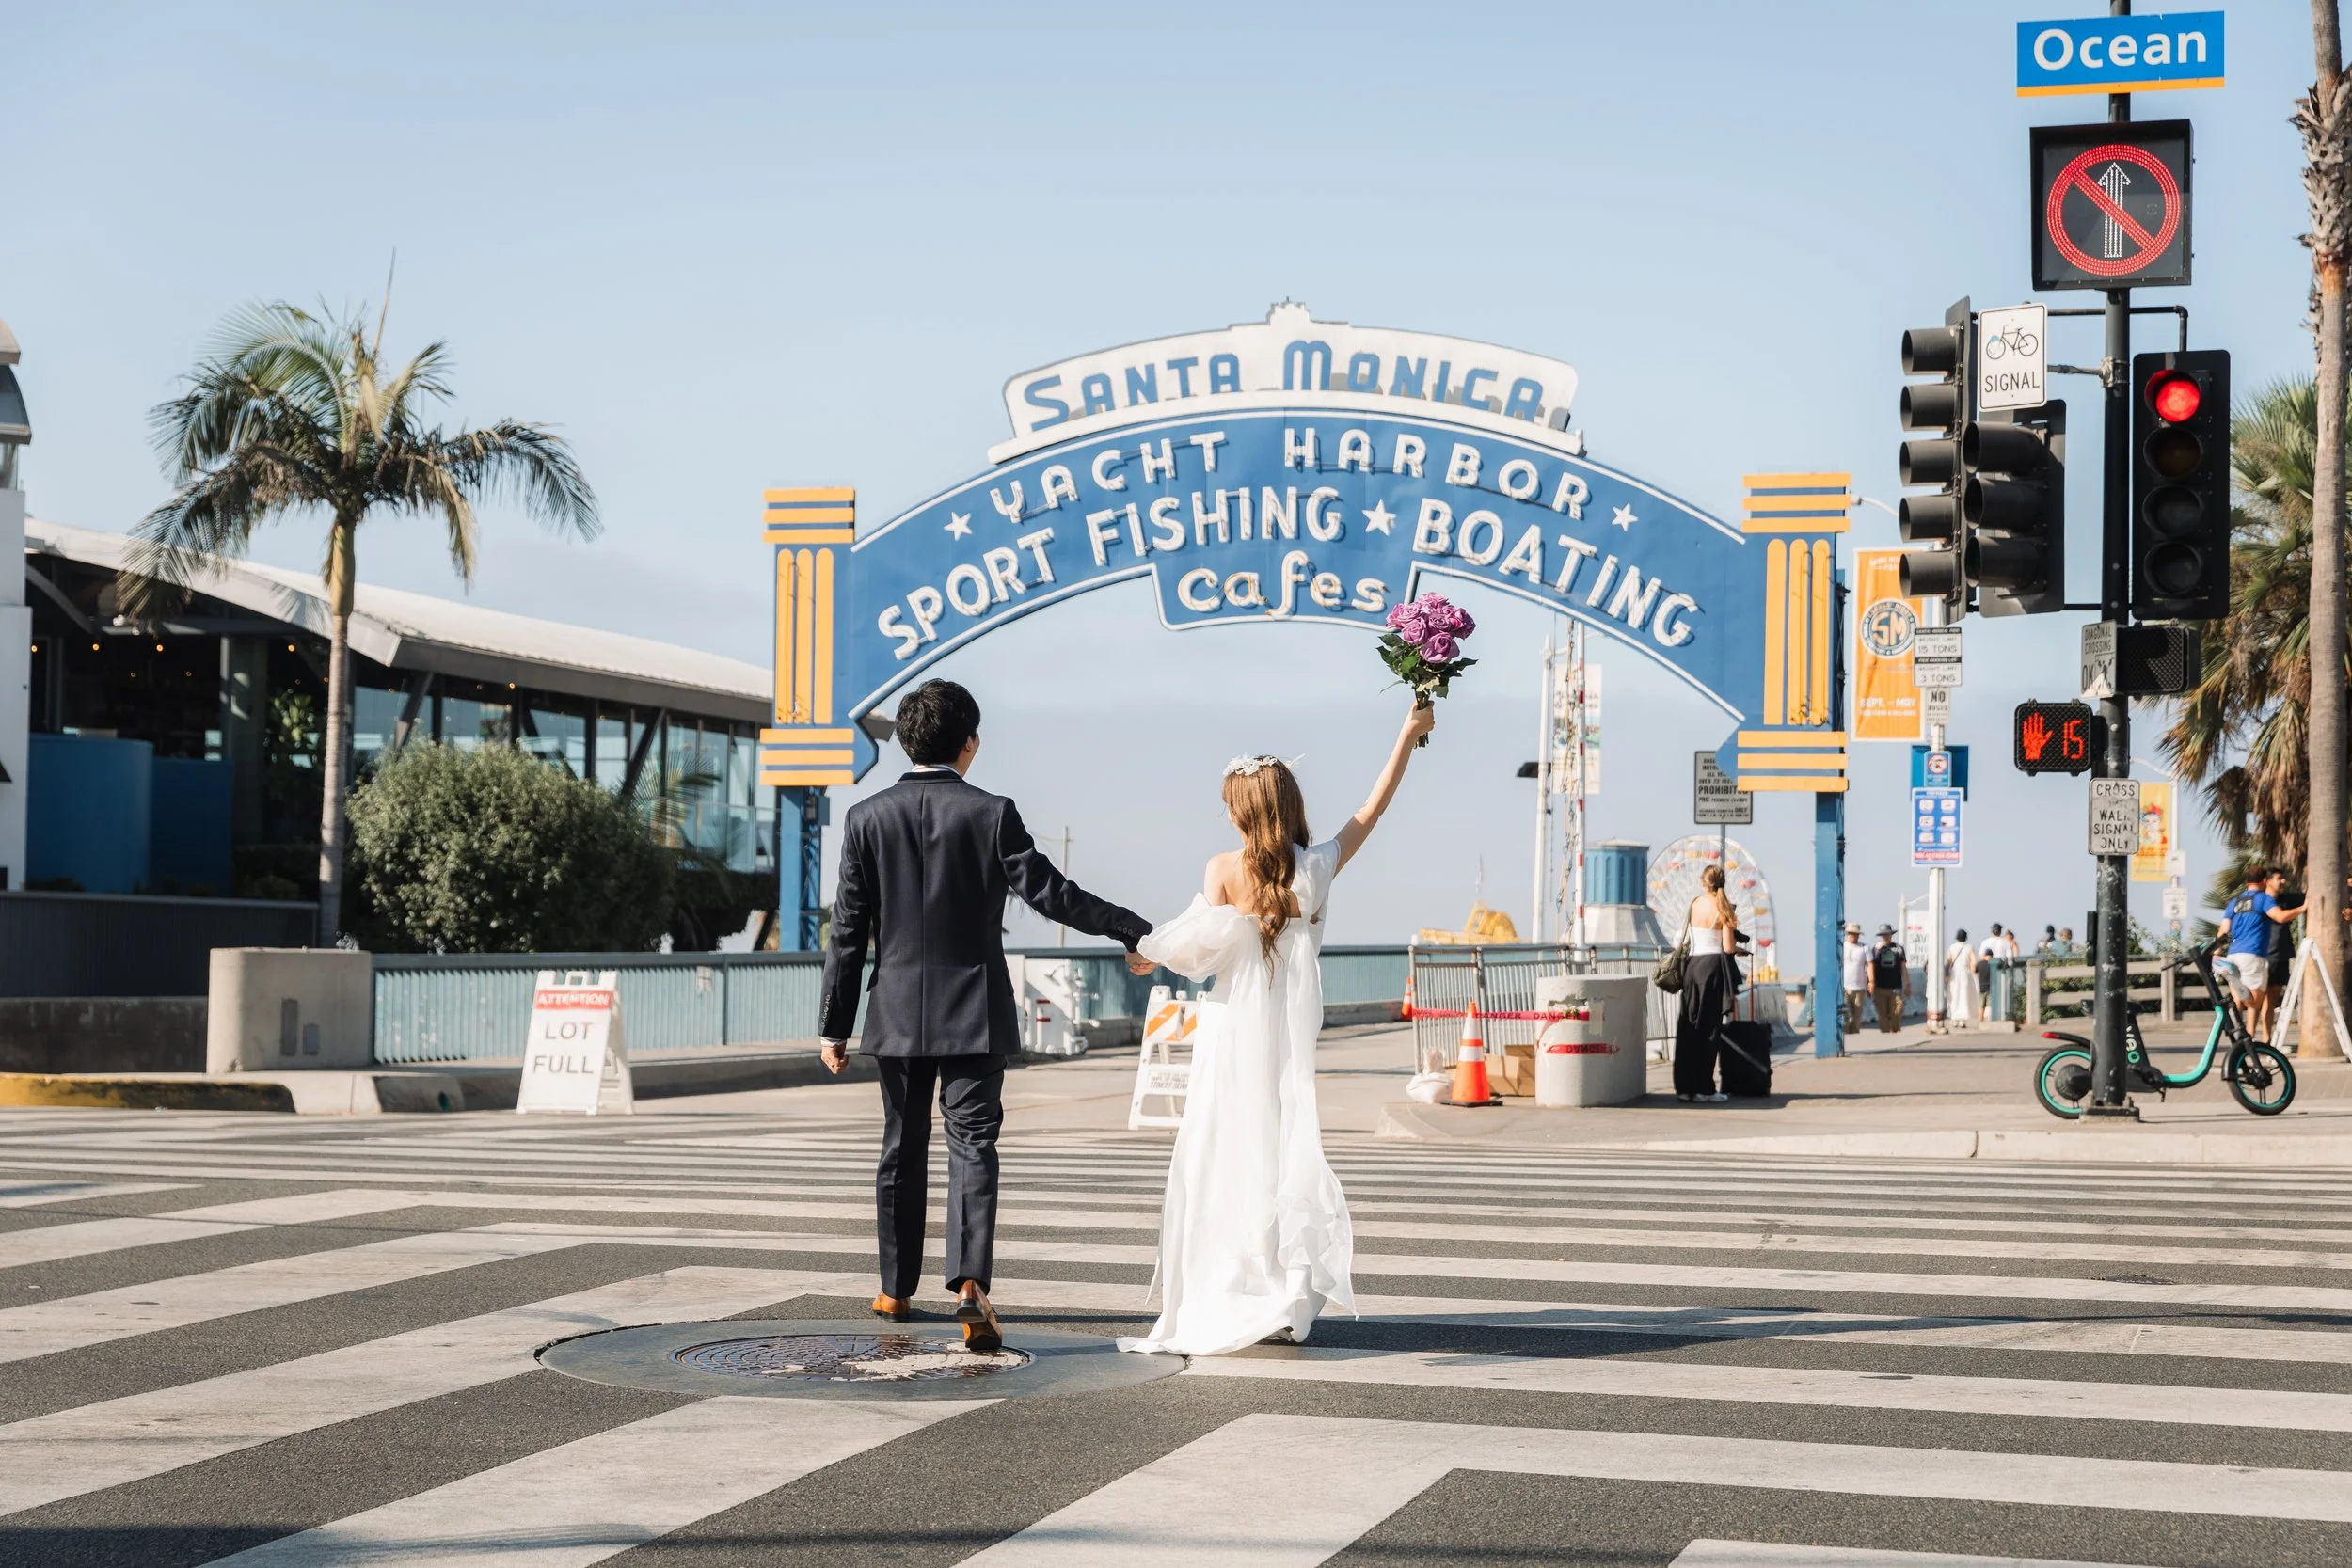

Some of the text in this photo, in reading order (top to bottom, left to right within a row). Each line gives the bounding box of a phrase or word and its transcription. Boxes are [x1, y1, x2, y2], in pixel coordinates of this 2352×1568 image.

[2033, 28, 2207, 71] Ocean
[1023, 340, 1544, 432] SANTA MONICA
[1984, 370, 2040, 394] SIGNAL
[989, 427, 1590, 524] YACHT HARBOR
[877, 485, 1698, 660] SPORT FISHING BOATING
[1871, 610, 1907, 647] SM
[2084, 626, 2112, 641] DIAGONAL
[1932, 644, 1958, 654] TONS
[2084, 640, 2111, 655] CROSSING
[1931, 673, 1956, 683] TONS
[2081, 663, 2094, 692] OK
[1931, 691, 1946, 703] NO
[2062, 719, 2085, 760] 15
[2096, 784, 2135, 797] CROSS
[537, 992, 610, 1006] ATTENTION
[545, 1022, 595, 1039] LOT
[533, 1054, 595, 1074] FULL
